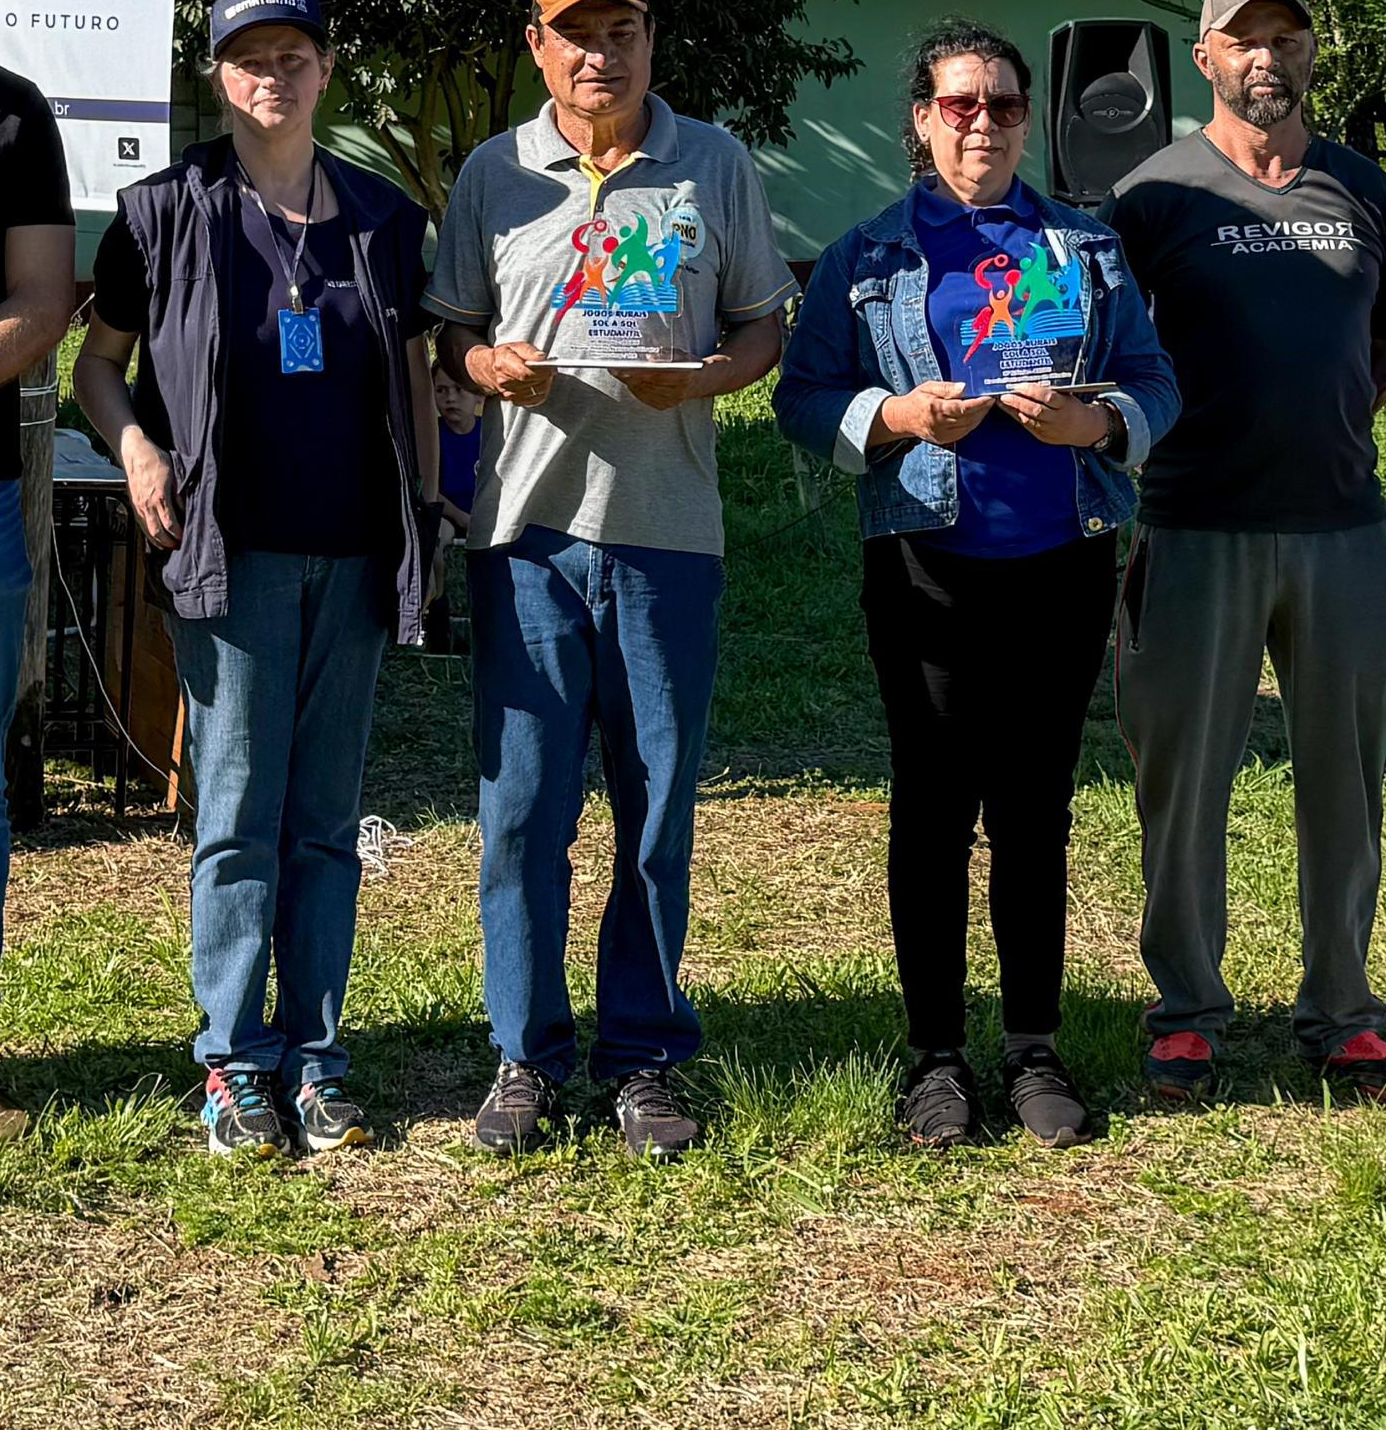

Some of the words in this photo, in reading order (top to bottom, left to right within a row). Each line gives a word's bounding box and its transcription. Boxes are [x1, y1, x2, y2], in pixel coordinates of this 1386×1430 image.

[5, 13, 18, 27] O
[31, 14, 120, 30] FUTURO
[55, 100, 70, 116] br
[1232, 239, 1354, 255] ACADEMIA
